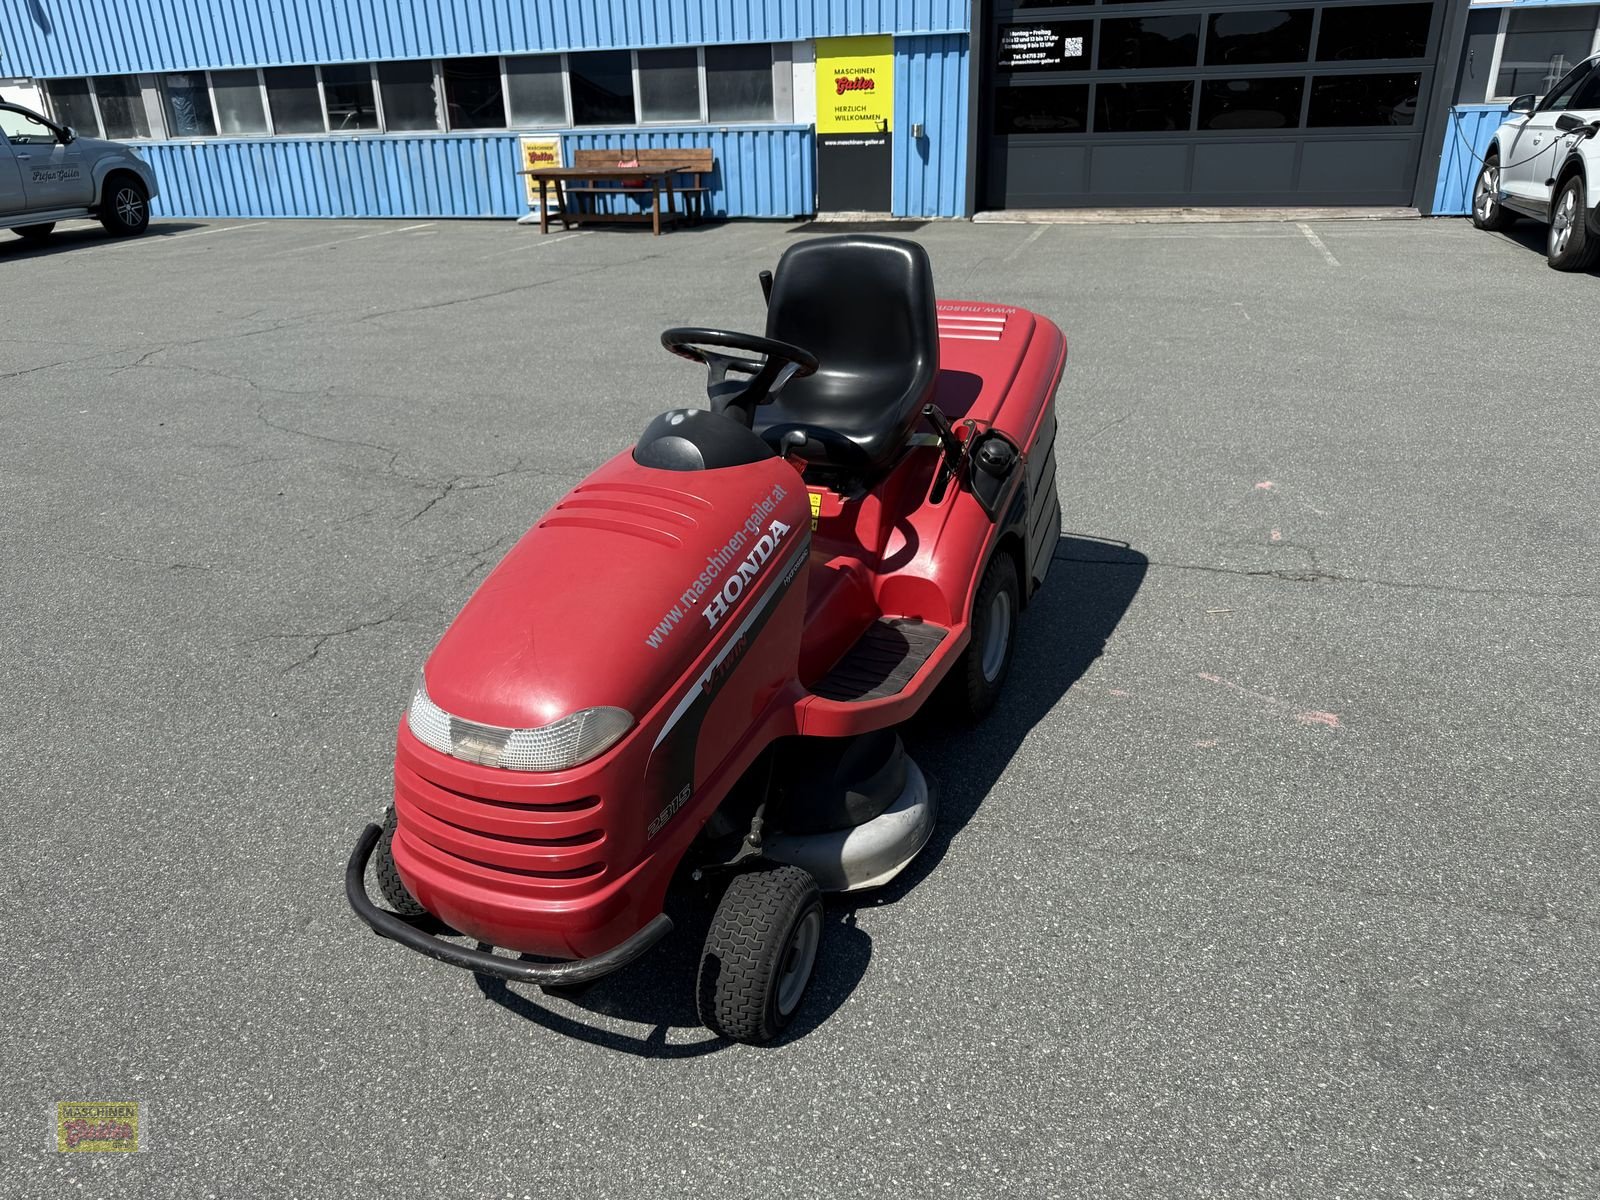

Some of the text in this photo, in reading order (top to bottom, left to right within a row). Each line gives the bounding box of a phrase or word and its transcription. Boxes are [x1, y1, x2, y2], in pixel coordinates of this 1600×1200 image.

[835, 76, 875, 95] Gailer
[645, 483, 788, 649] www.maschinen-gailer.at
[702, 519, 791, 630] HONDA
[647, 783, 691, 841] 2315
